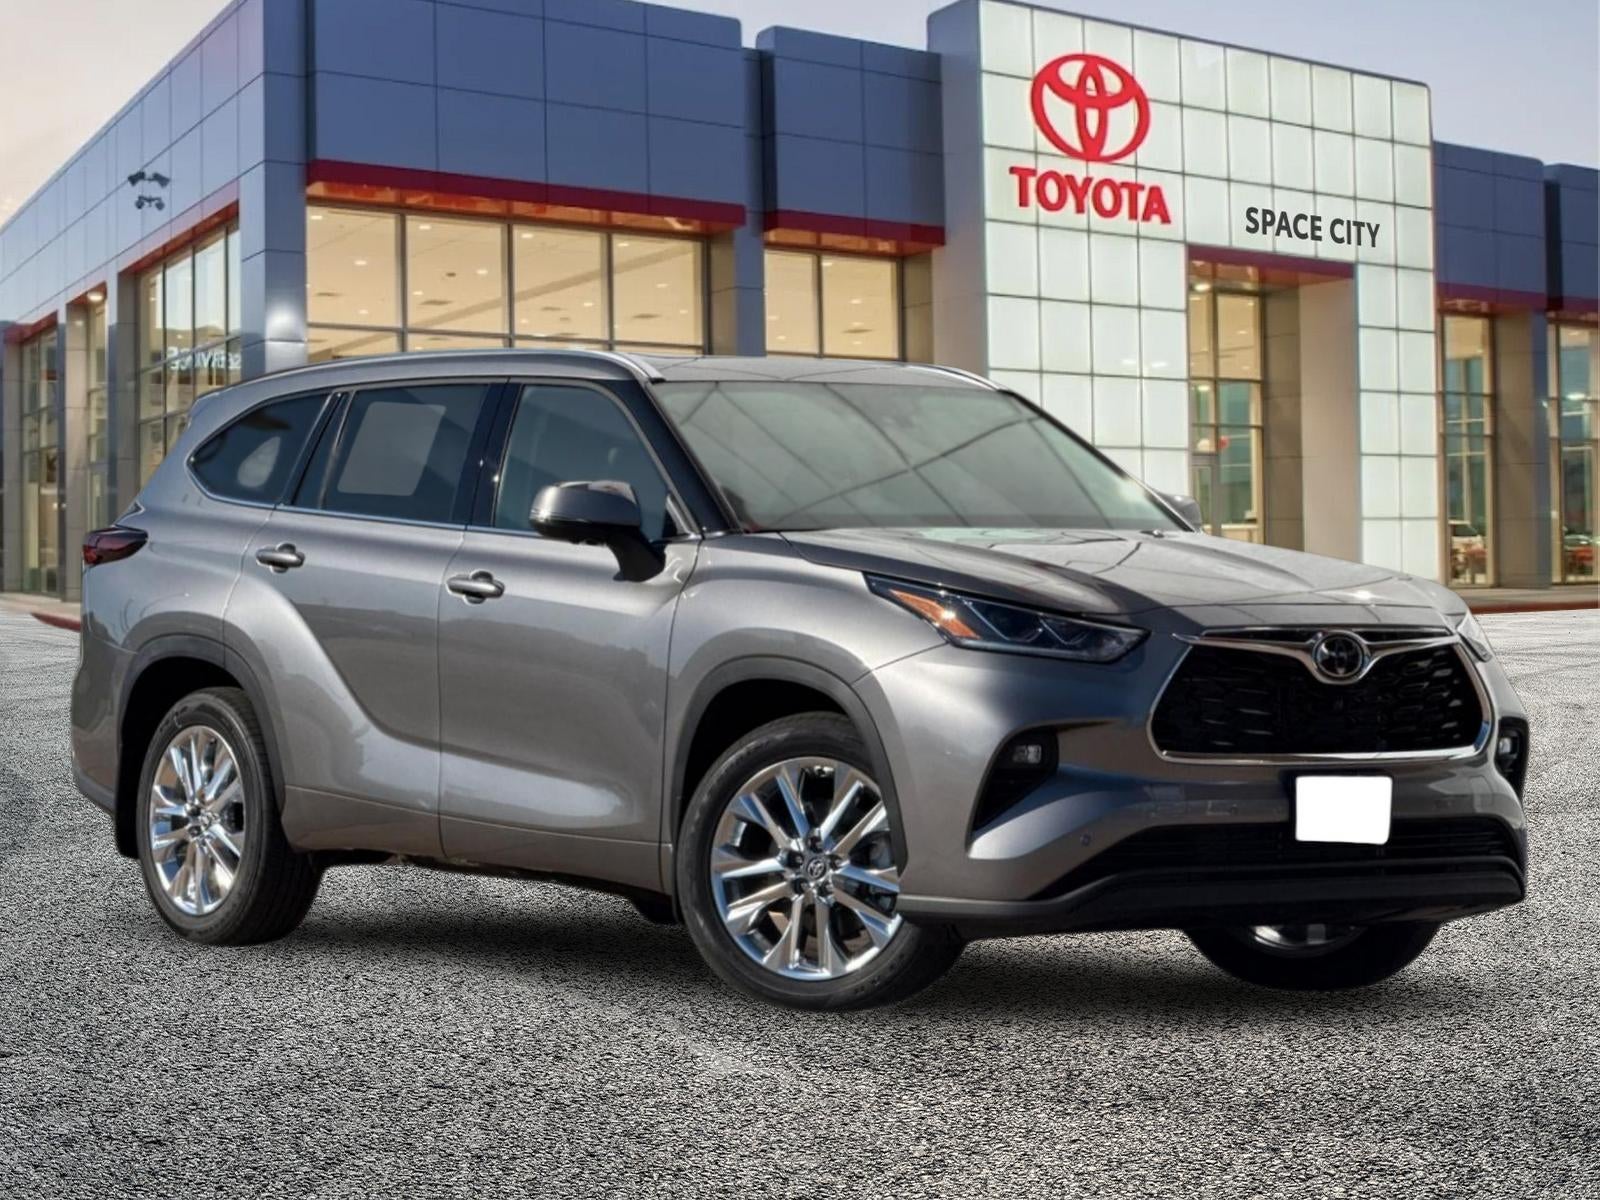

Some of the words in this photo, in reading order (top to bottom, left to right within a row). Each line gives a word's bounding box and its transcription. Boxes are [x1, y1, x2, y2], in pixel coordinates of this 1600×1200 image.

[1009, 166, 1171, 224] TOYOTA
[1245, 206, 1323, 242] SPACE
[1329, 218, 1380, 248] CITY
